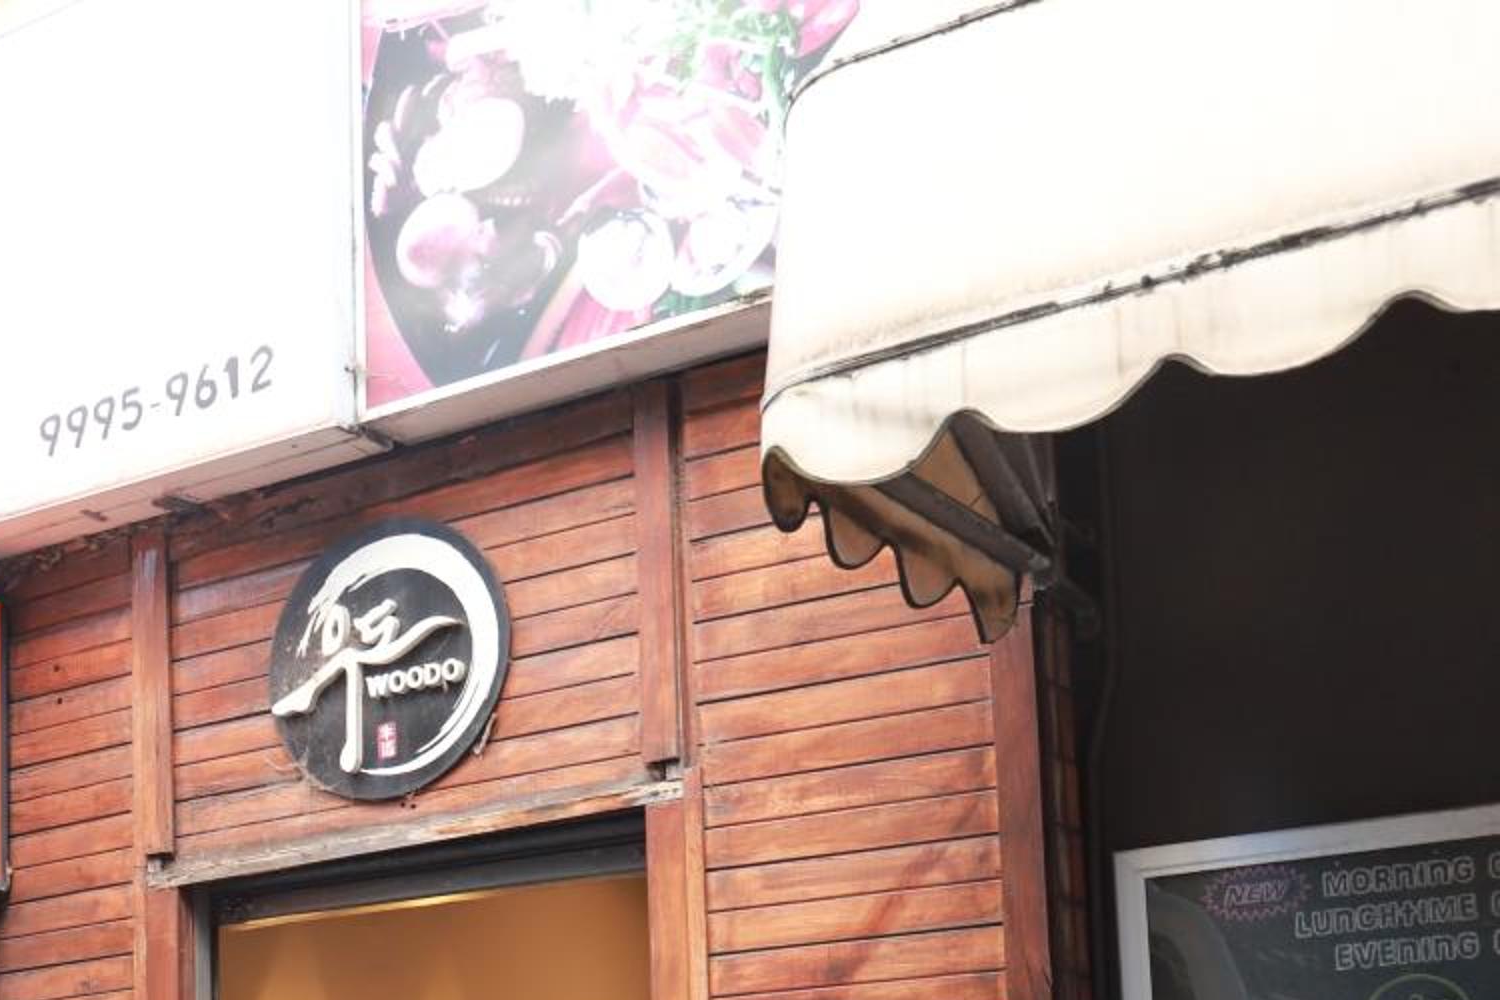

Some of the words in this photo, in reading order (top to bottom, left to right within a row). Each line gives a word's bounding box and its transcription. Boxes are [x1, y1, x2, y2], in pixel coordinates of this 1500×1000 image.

[40, 345, 273, 456] 9995-9612
[365, 658, 464, 698] WOODO
[1223, 880, 1286, 909] NEW
